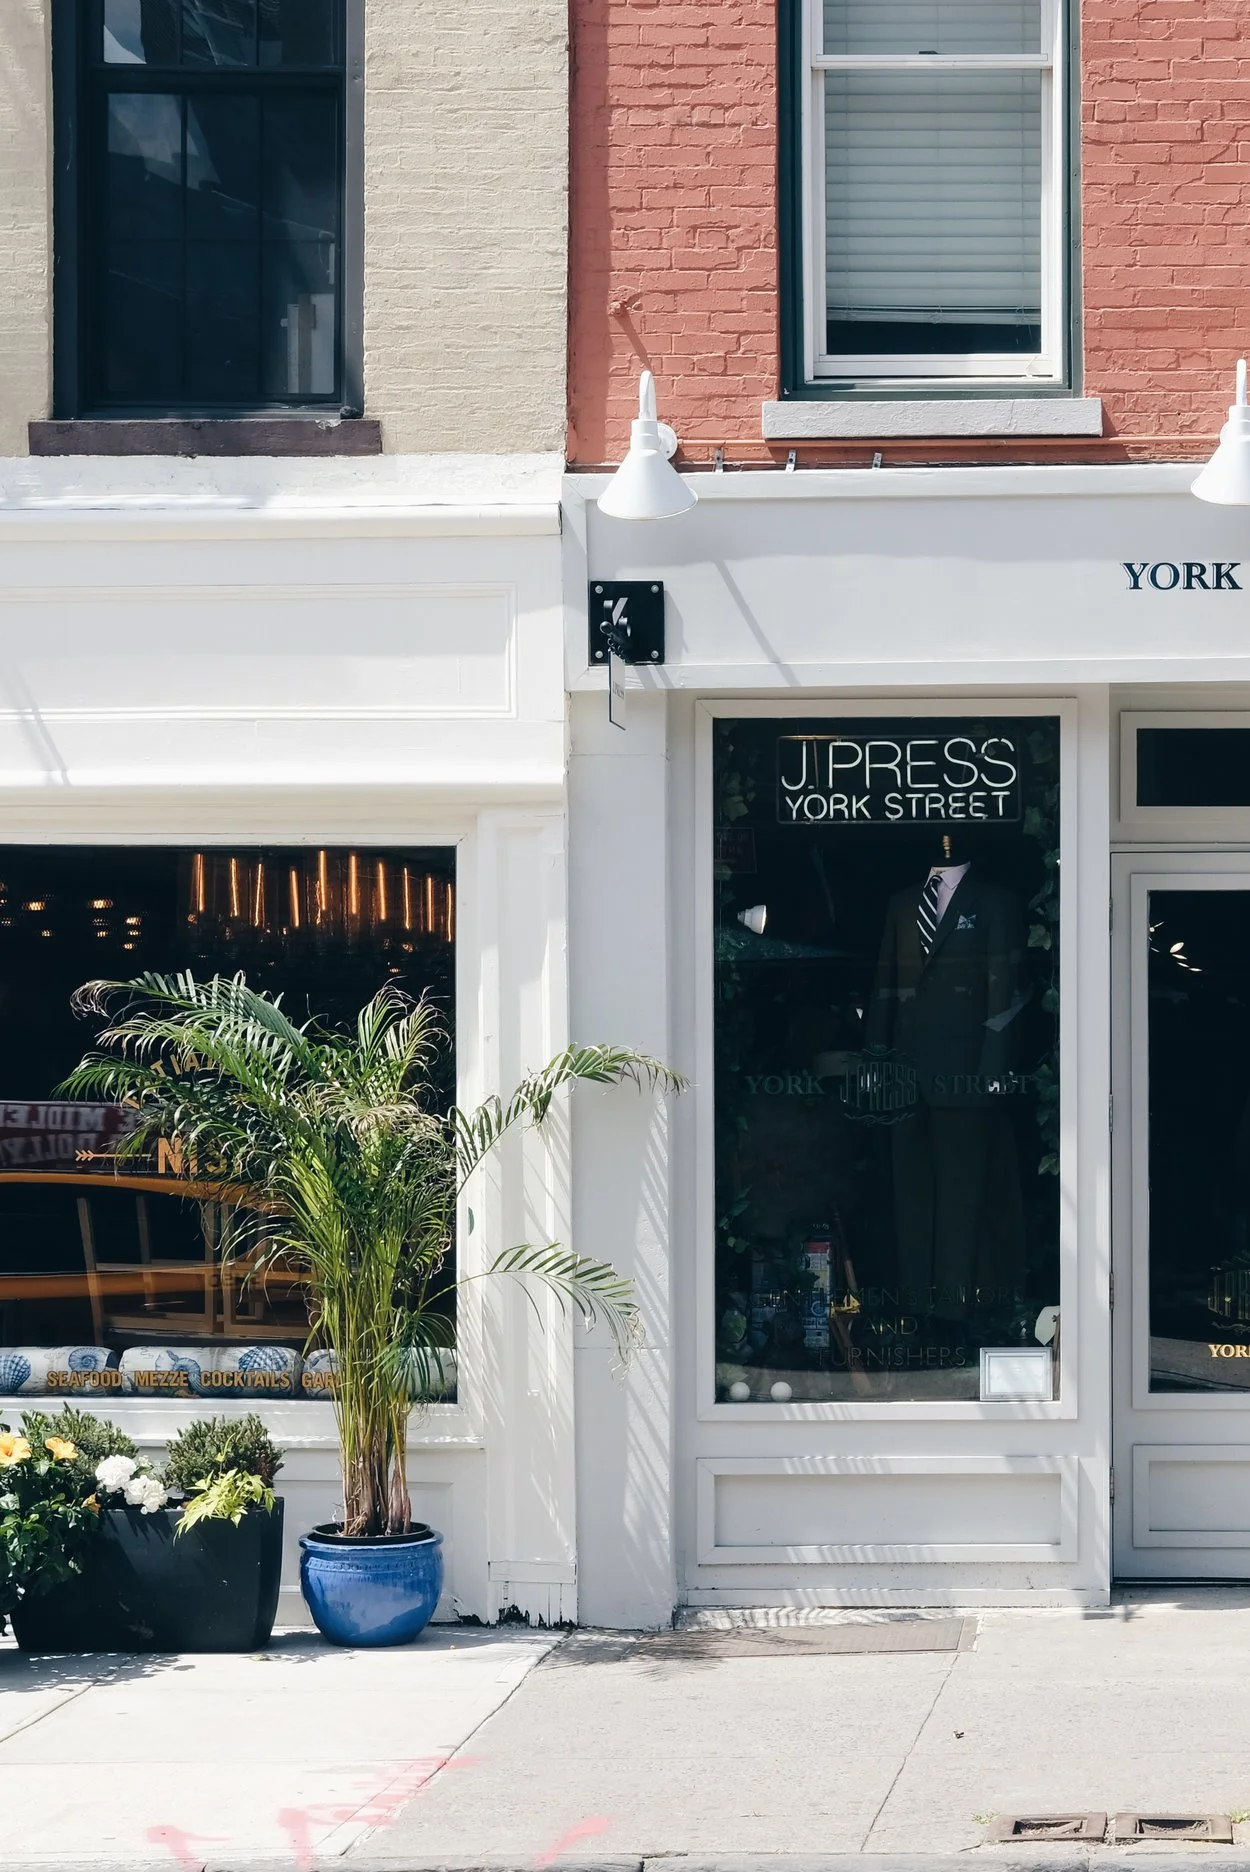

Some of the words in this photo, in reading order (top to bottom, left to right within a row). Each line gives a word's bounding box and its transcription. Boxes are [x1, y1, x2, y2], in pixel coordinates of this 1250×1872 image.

[1123, 561, 1244, 591] YORK
[781, 737, 1017, 791] J.PRESS
[784, 794, 871, 821] YORK
[884, 791, 1011, 821] STREET
[743, 1075, 825, 1095] YORK
[839, 1061, 920, 1112] J.PRESS
[933, 1074, 1033, 1095] STREET
[926, 1285, 1024, 1305] TAILORS
[861, 1315, 920, 1336] AND
[47, 1371, 122, 1388] SEAFOOD
[135, 1371, 189, 1387] MEZZE
[200, 1371, 291, 1388] COCKTAILS
